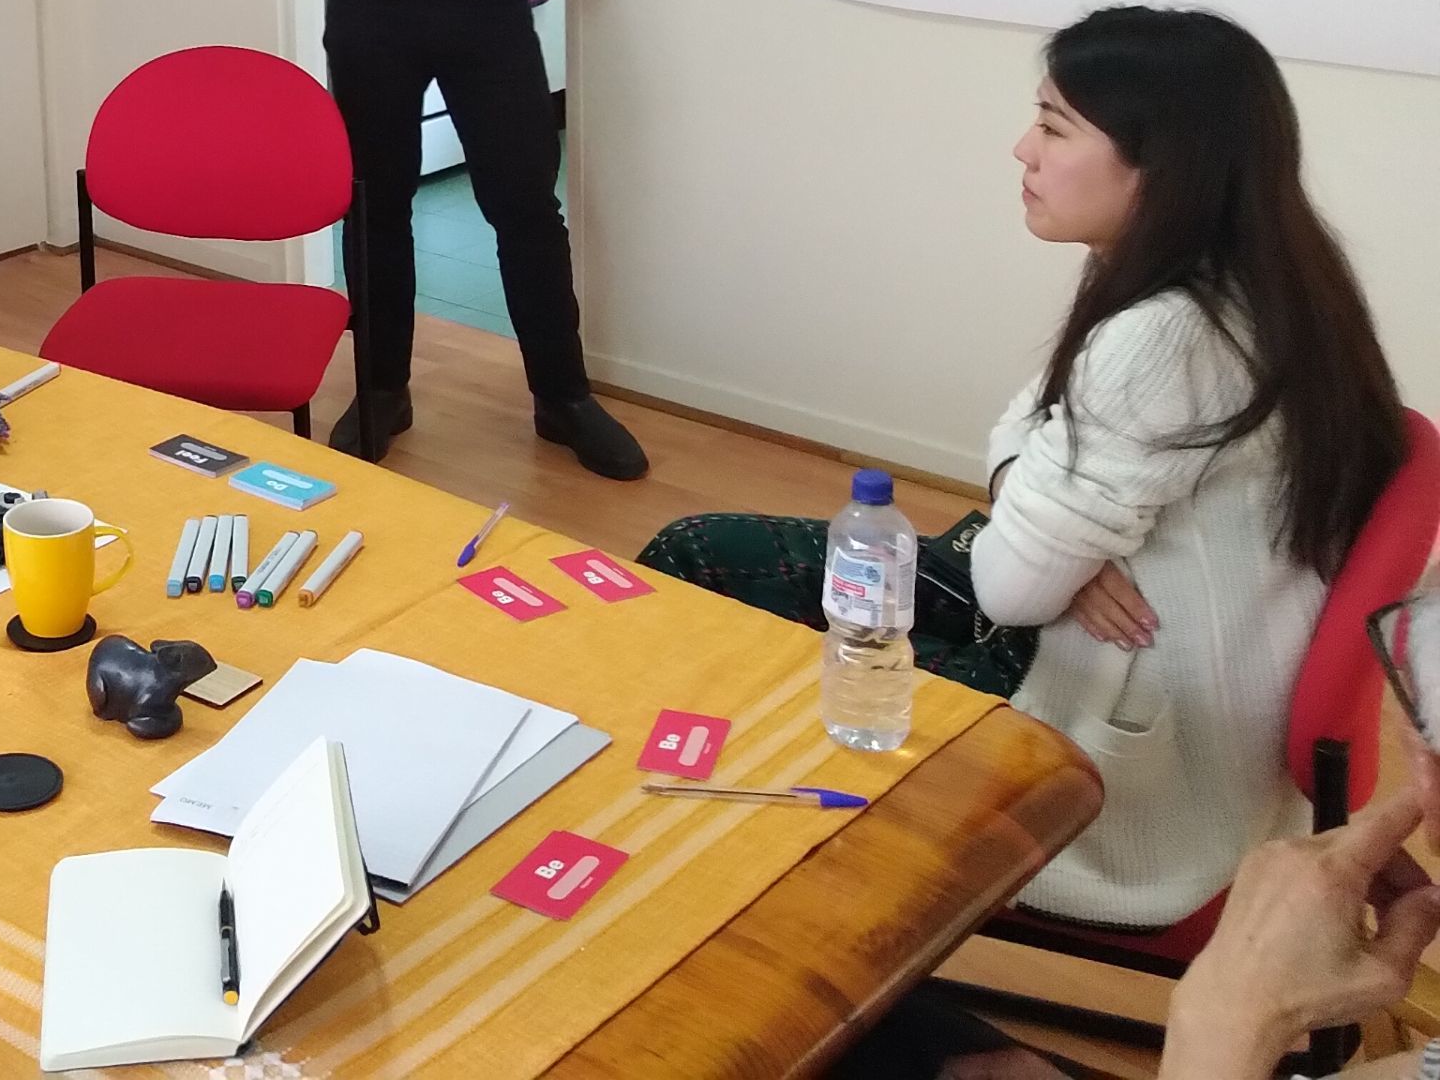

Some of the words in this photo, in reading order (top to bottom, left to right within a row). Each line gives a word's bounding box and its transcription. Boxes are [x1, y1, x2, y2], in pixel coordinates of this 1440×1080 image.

[174, 449, 209, 464] Feel
[266, 479, 290, 491] Do
[583, 571, 606, 585] Be
[491, 590, 515, 605] Be
[658, 733, 682, 750] Be
[534, 859, 565, 880] Be
